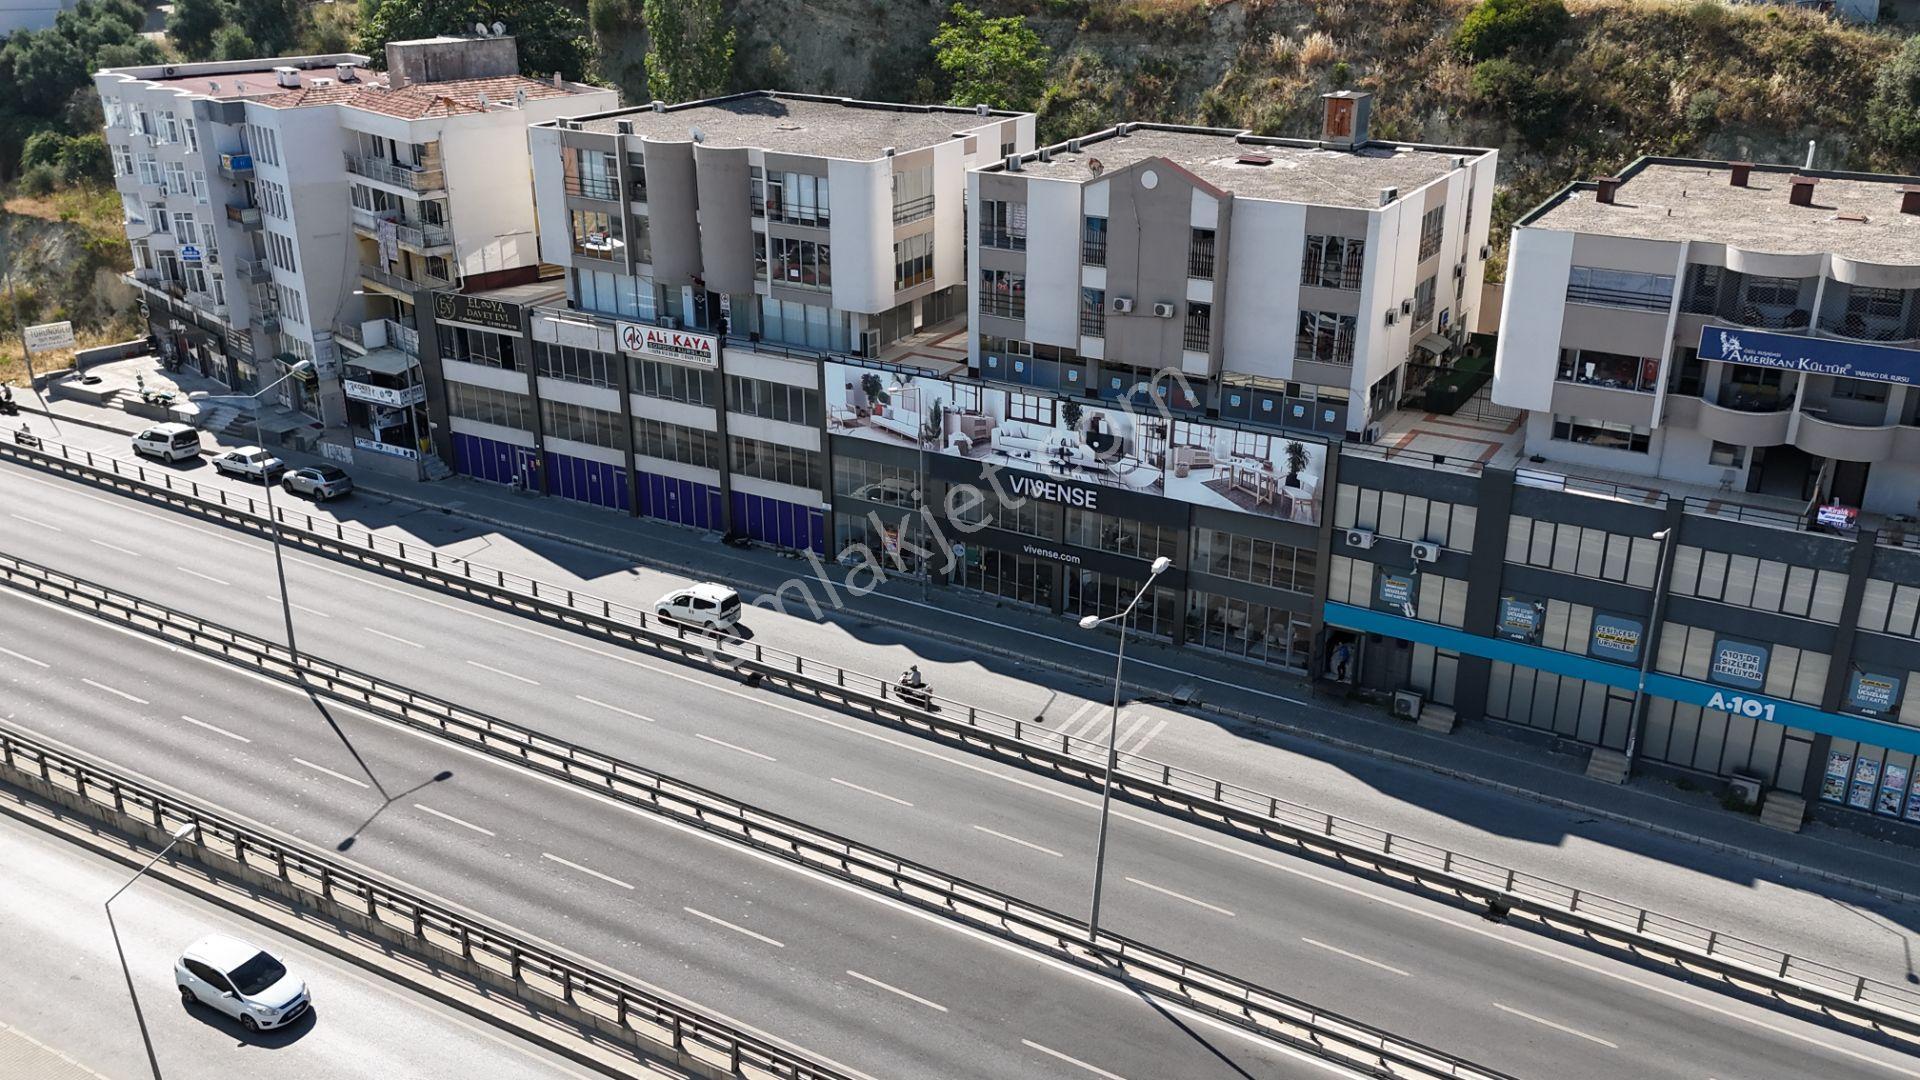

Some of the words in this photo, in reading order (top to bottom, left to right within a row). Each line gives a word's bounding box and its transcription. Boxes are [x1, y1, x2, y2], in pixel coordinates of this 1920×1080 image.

[673, 334, 711, 351] KAYA
[1798, 357, 1847, 375] KÜLTÜR
[1009, 474, 1097, 509] VIVENSE
[1023, 544, 1081, 564] vivense.com
